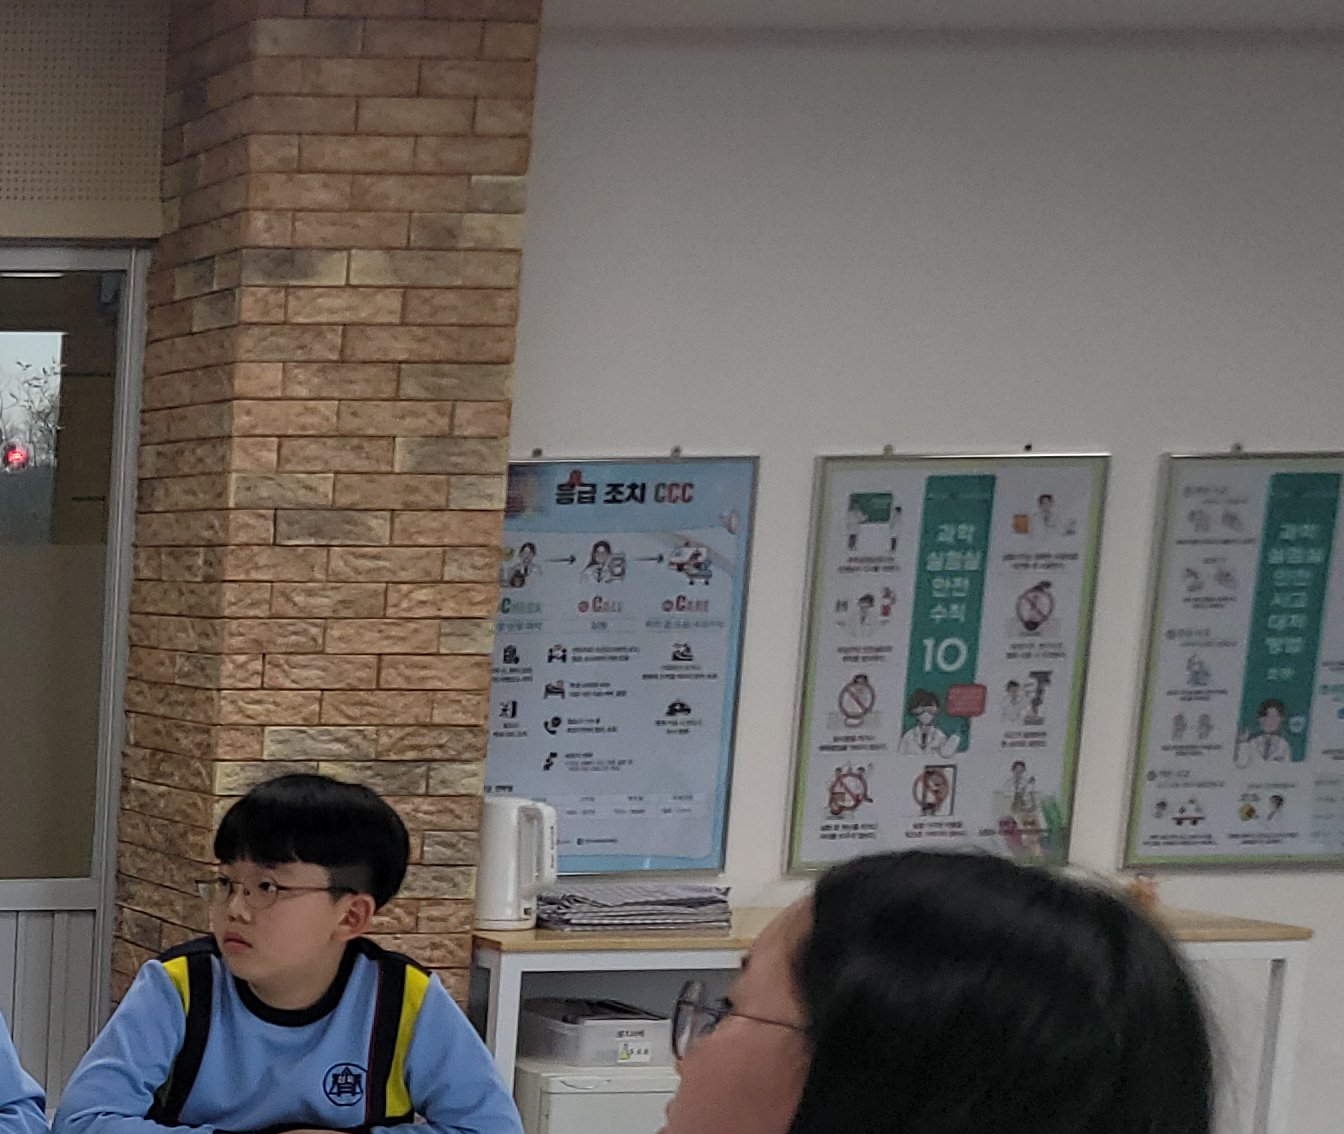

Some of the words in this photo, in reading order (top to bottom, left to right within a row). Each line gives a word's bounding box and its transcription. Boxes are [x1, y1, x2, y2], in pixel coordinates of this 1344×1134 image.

[555, 482, 597, 504] 응급
[603, 482, 646, 504] 조치
[653, 482, 695, 504] CCC
[936, 523, 976, 544] 과학
[922, 637, 968, 672] 10
